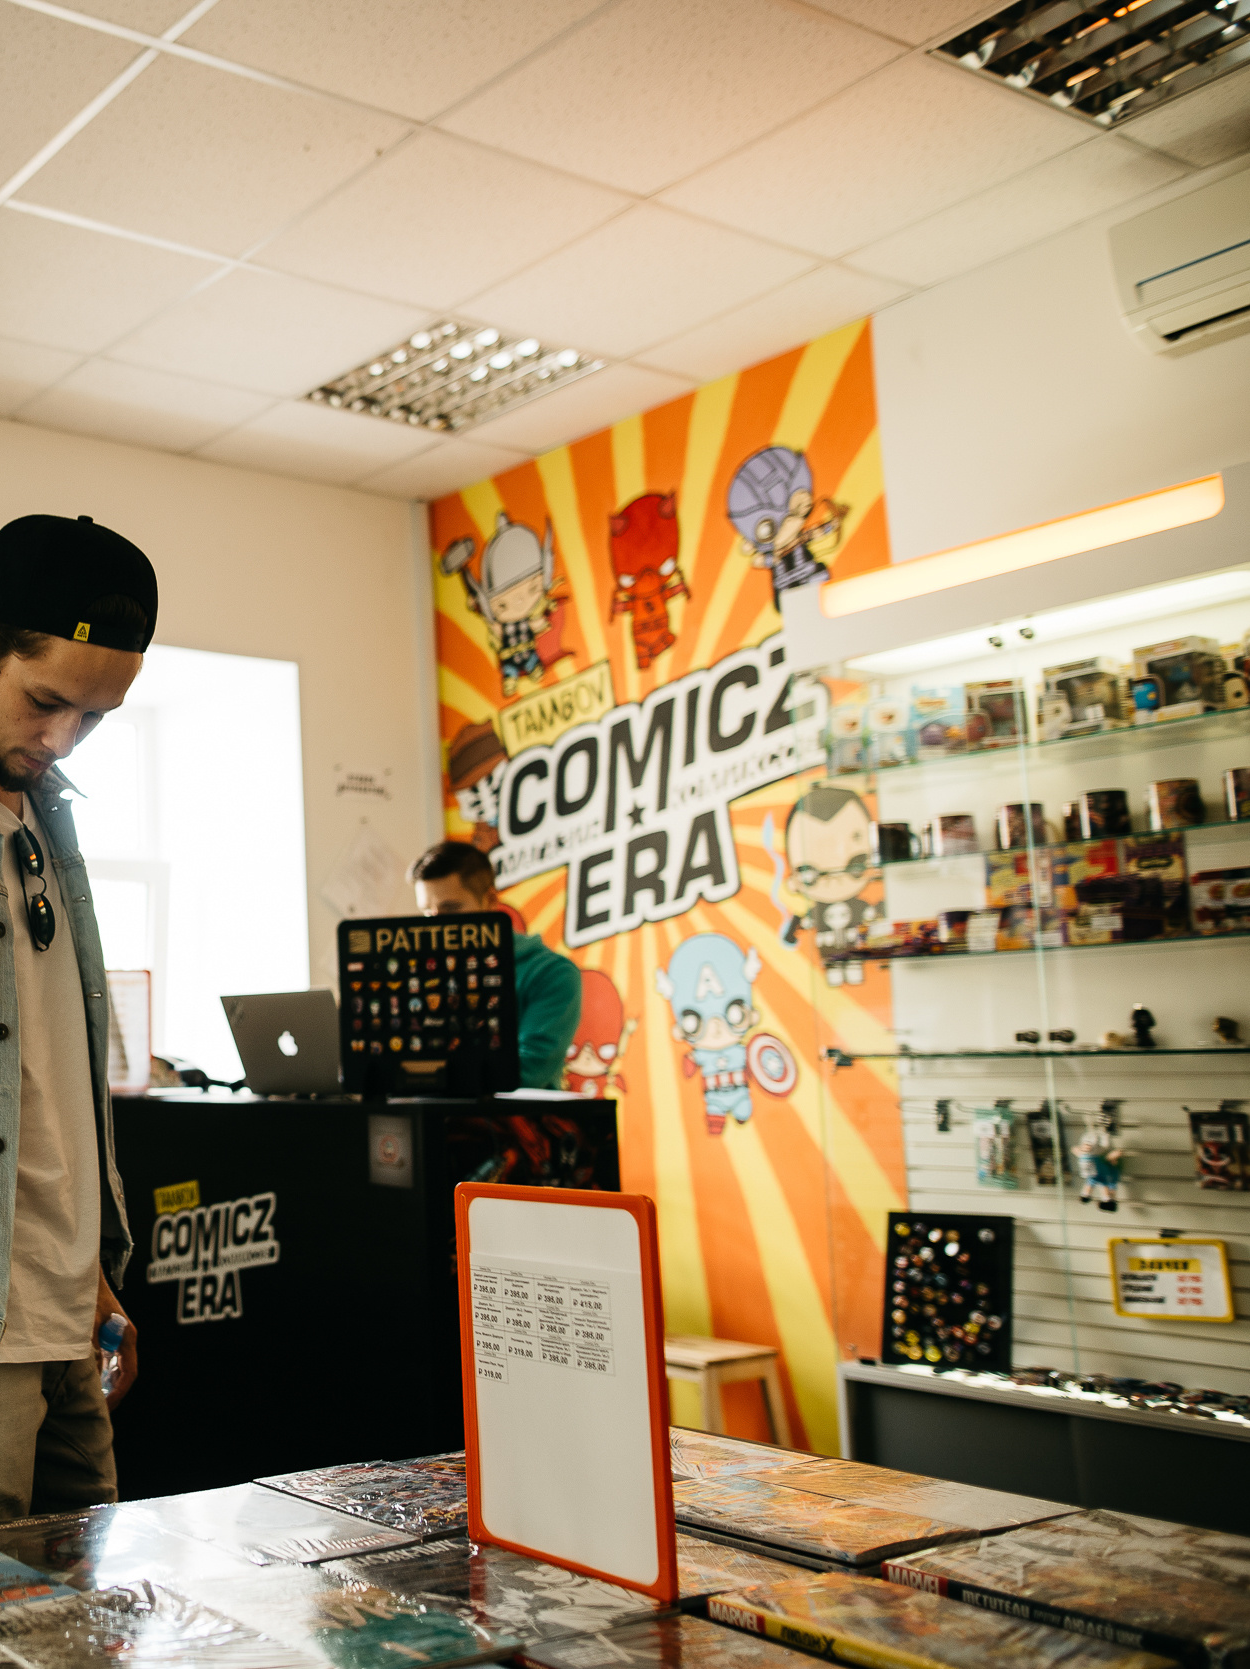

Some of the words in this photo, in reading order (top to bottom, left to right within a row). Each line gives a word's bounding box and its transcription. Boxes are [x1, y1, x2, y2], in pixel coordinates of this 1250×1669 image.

[511, 679, 607, 743] TAMBOV
[575, 809, 727, 932] ERA
[375, 922, 501, 953] PATTERN
[157, 1197, 272, 1271] COMICZ
[182, 1271, 238, 1318] ERA
[888, 1564, 940, 1595] MARVEL
[708, 1600, 759, 1633] MARVEL
